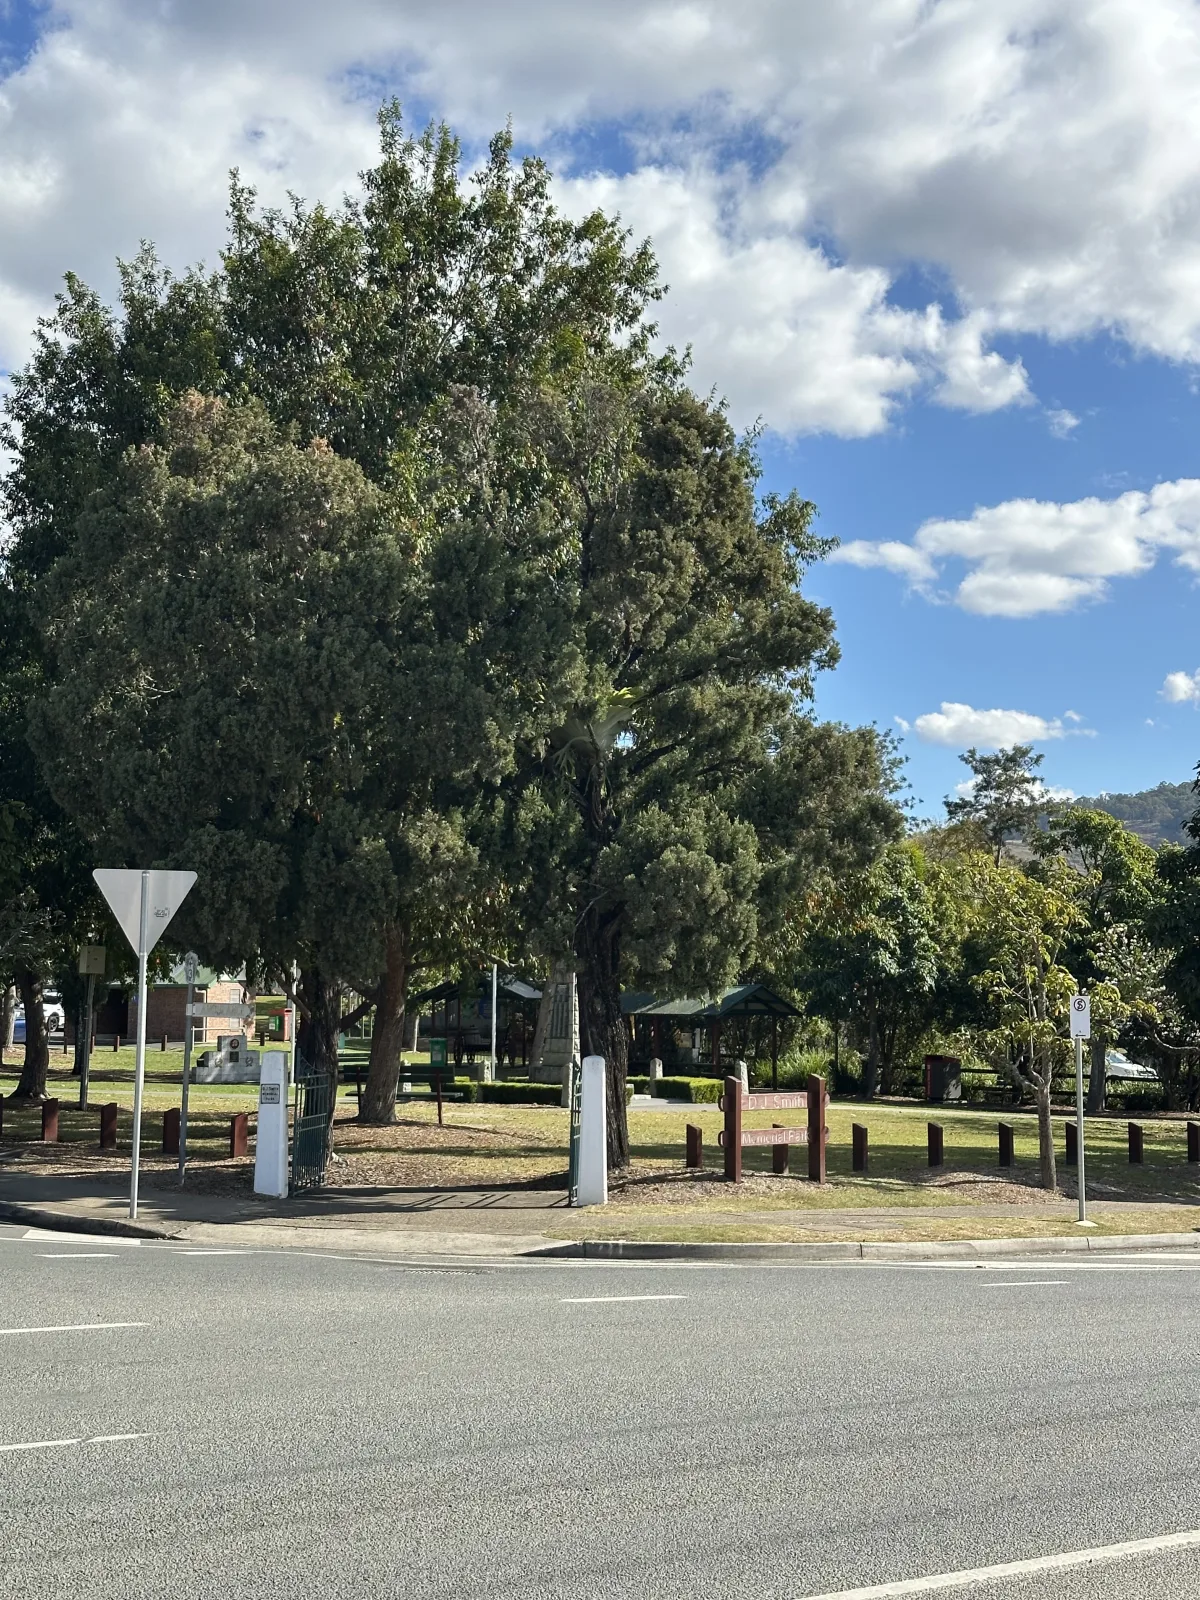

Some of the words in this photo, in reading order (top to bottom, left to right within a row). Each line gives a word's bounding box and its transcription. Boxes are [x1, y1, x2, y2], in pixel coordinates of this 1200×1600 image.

[748, 1096, 757, 1110] D
[761, 1096, 767, 1110] J
[773, 1095, 805, 1109] Smith
[742, 1131, 786, 1145] Memorial
[788, 1129, 809, 1143] Park
